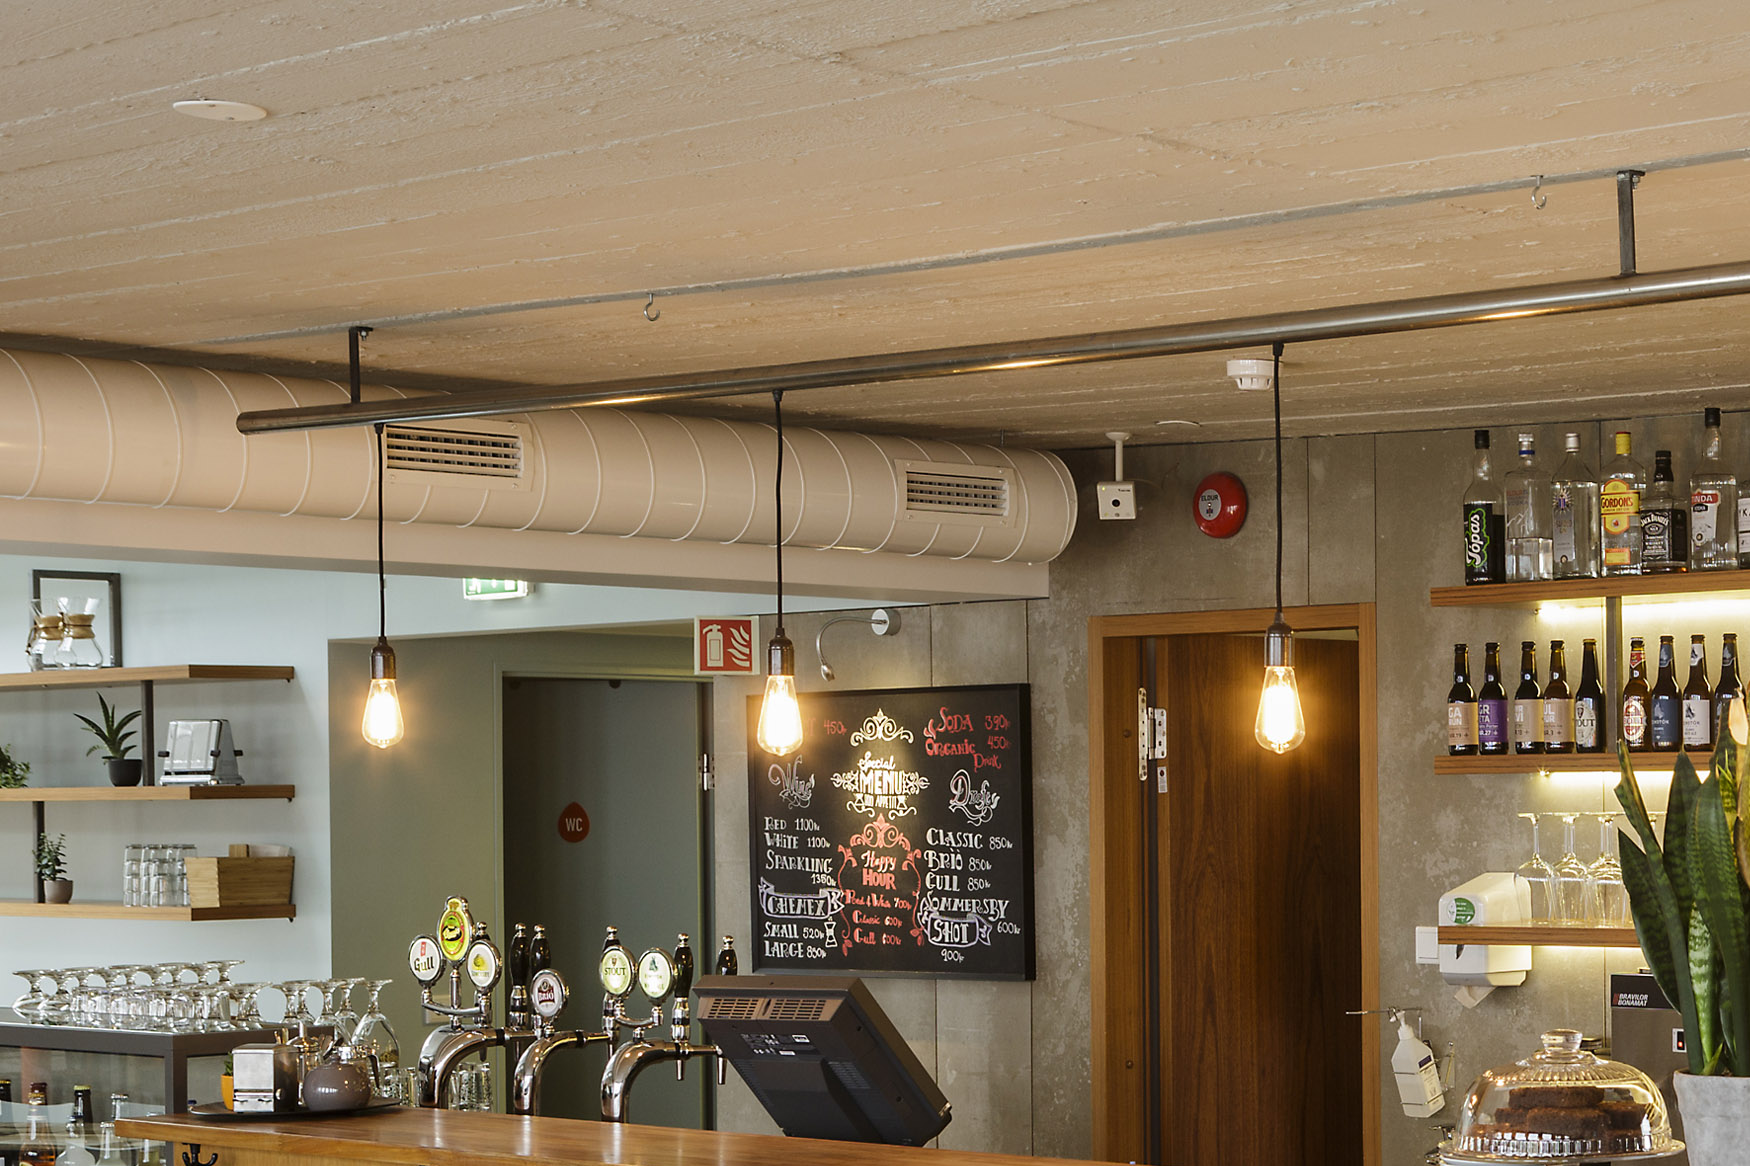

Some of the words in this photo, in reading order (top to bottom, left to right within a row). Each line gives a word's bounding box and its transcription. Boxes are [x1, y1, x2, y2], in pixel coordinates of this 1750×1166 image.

[1465, 514, 1483, 565] Tópas
[860, 769, 904, 795] MENU
[565, 817, 583, 832] WC
[926, 827, 984, 849] CLASSIC
[765, 849, 833, 874] SPARKLING
[862, 867, 897, 890] HOUR
[767, 896, 827, 917] CHEMEX
[763, 921, 800, 939] SMALL
[931, 919, 970, 944] SHOT
[764, 940, 805, 958] LARGE
[414, 954, 434, 973] Gull
[604, 966, 627, 977] STOUT
[1619, 993, 1649, 1001] BRAVILOR
